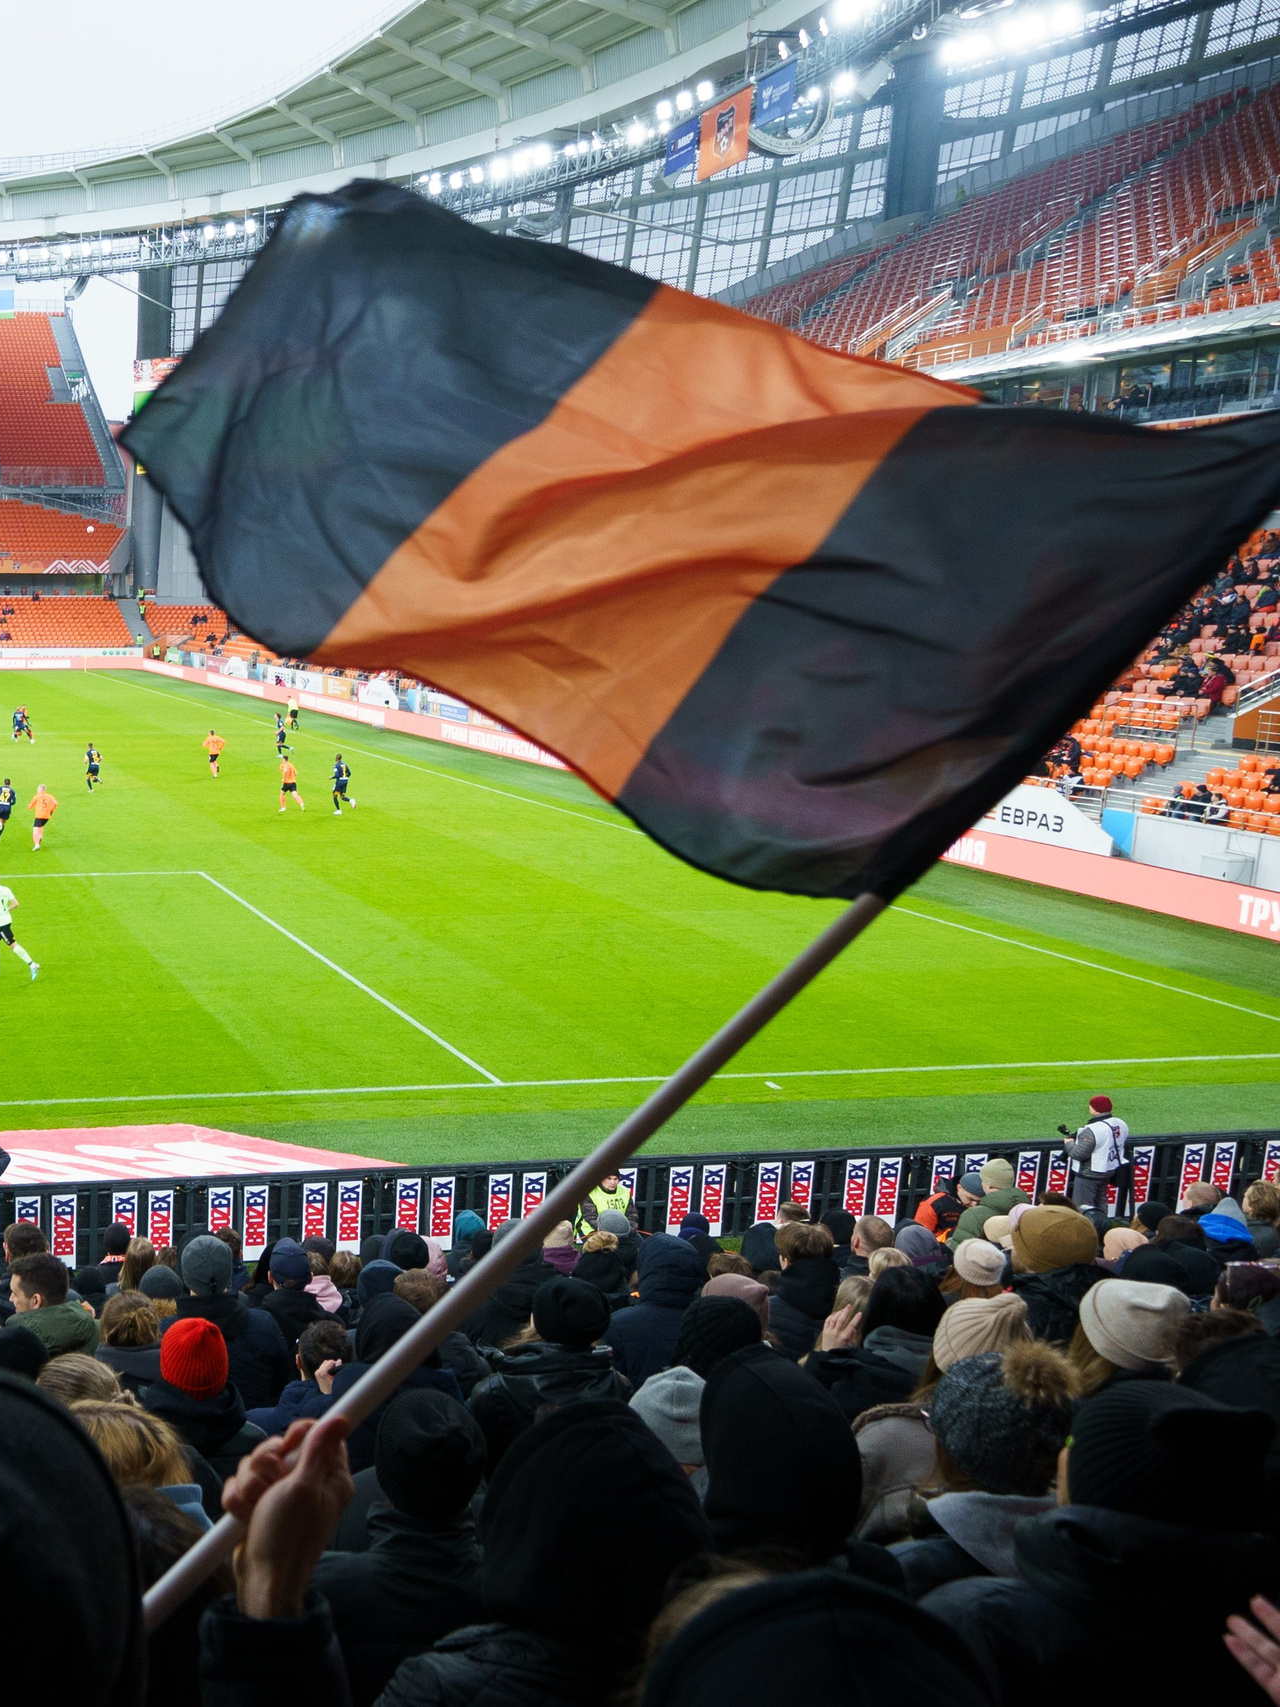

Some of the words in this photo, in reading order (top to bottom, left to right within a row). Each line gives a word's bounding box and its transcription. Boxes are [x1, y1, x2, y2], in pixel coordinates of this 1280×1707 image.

[1000, 806, 1065, 833] ЕВРАЗ
[339, 1183, 361, 1241] BROZEX
[431, 1179, 453, 1236] BROZEX
[702, 1167, 724, 1223] BROZEX
[757, 1164, 780, 1221] BROZEX
[875, 1159, 900, 1215] BROZEX
[54, 1197, 76, 1256] BROZEX
[245, 1188, 266, 1246] BROZEX
